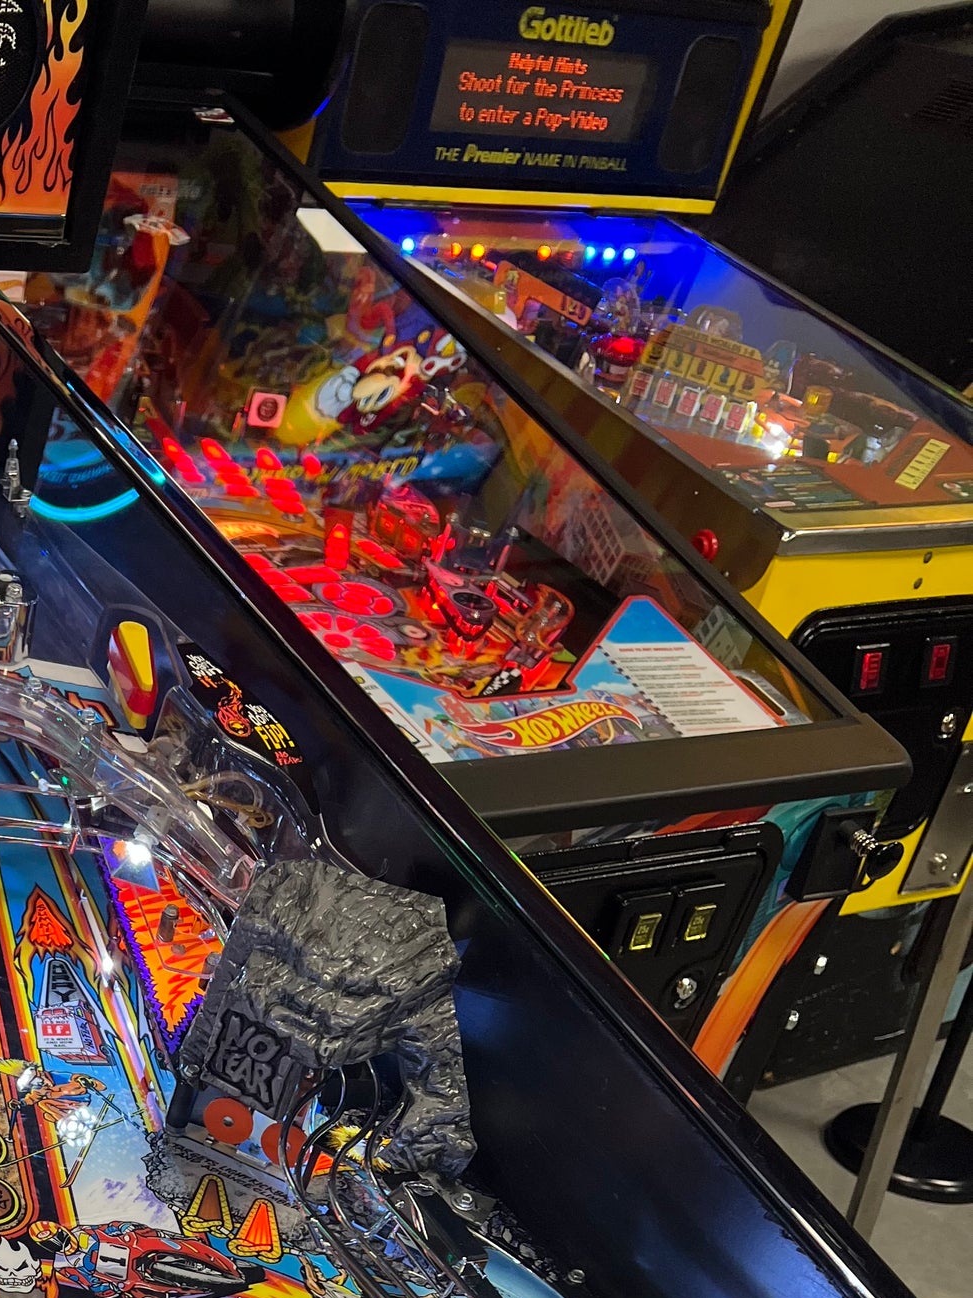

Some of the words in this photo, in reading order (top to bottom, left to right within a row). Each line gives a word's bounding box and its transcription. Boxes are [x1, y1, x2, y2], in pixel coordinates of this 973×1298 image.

[519, 6, 615, 46] Gottlieb
[508, 52, 554, 75] Helpful
[555, 56, 588, 75] Hints
[458, 71, 503, 94] Shoot
[505, 76, 530, 95] for
[533, 78, 557, 97] the
[560, 80, 624, 103] Princess
[459, 102, 474, 121] to
[478, 105, 520, 124] enter
[522, 112, 532, 125] a
[534, 107, 608, 133] Pop-Video
[435, 146, 461, 162] THE
[463, 143, 521, 164] Premier
[522, 151, 561, 167] NAME
[563, 154, 578, 168] IN
[579, 156, 627, 171] PINBALL
[227, 1015, 281, 1062] NO
